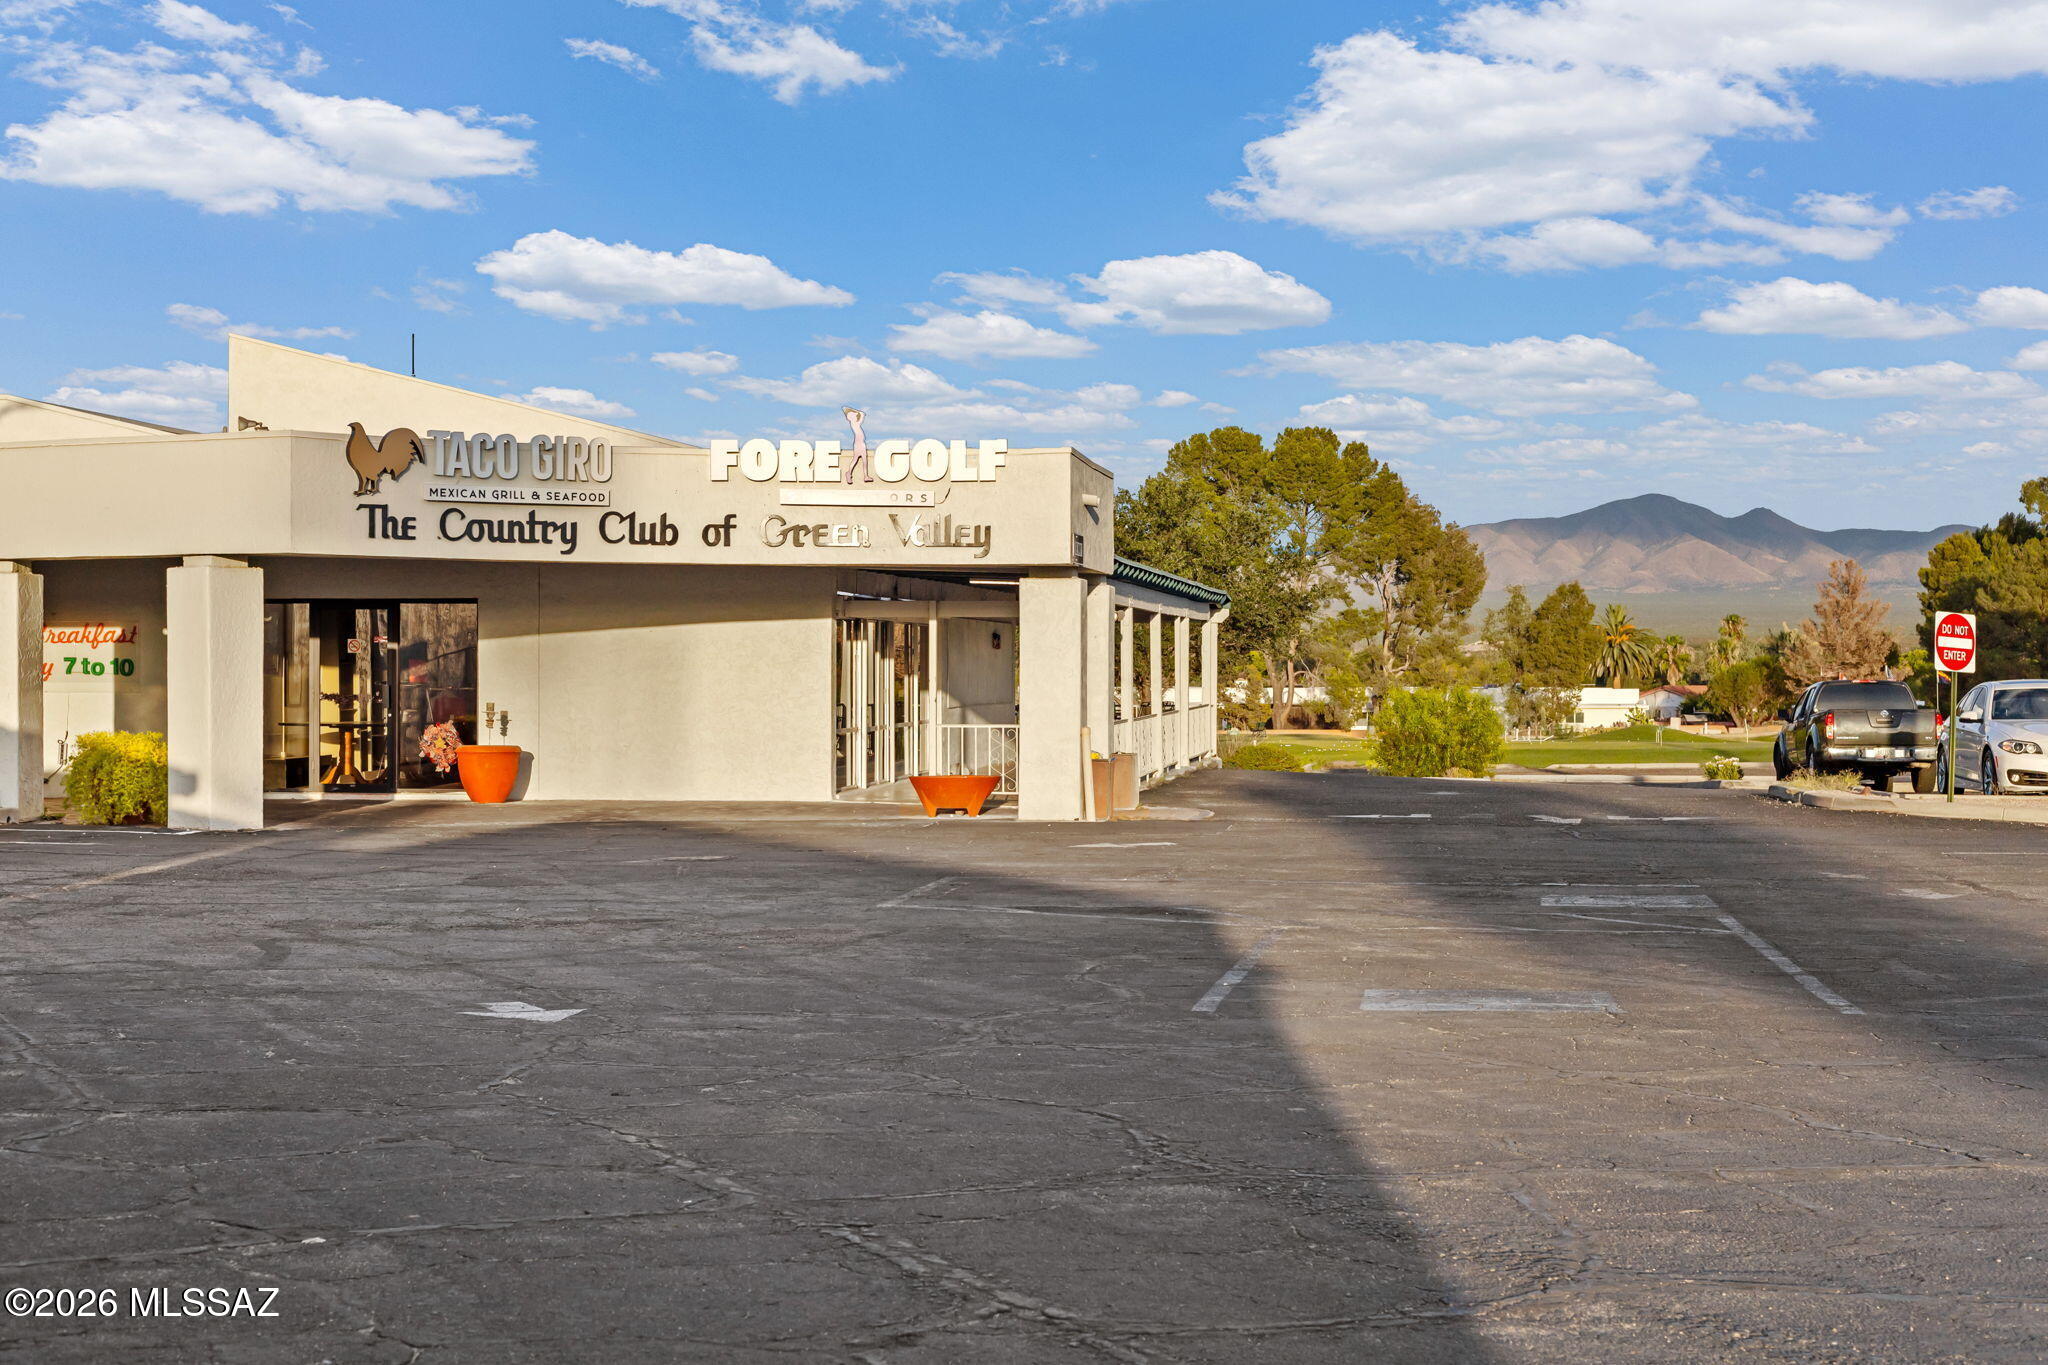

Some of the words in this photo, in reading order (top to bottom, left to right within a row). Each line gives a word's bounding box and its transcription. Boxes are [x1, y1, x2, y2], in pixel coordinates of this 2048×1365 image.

[427, 430, 519, 480] TACO
[531, 434, 612, 483] GIRO
[710, 438, 842, 482] FORE
[874, 438, 1008, 482] GOLF
[429, 488, 486, 499] MEXICAN
[492, 490, 525, 501] GRILL
[532, 491, 541, 501] &
[546, 492, 605, 502] SEAFOOD
[356, 503, 417, 540] The
[439, 508, 577, 555] Country
[599, 511, 679, 546] Club
[702, 514, 737, 547] of
[760, 514, 871, 548] Green
[888, 513, 991, 559] Valley
[42, 623, 137, 650] reakfast
[1942, 624, 1952, 634] DO
[1955, 625, 1968, 636] NOT
[63, 657, 77, 675] 7
[81, 658, 105, 676] to
[110, 658, 135, 676] 10
[1943, 650, 1966, 661] ENTER
